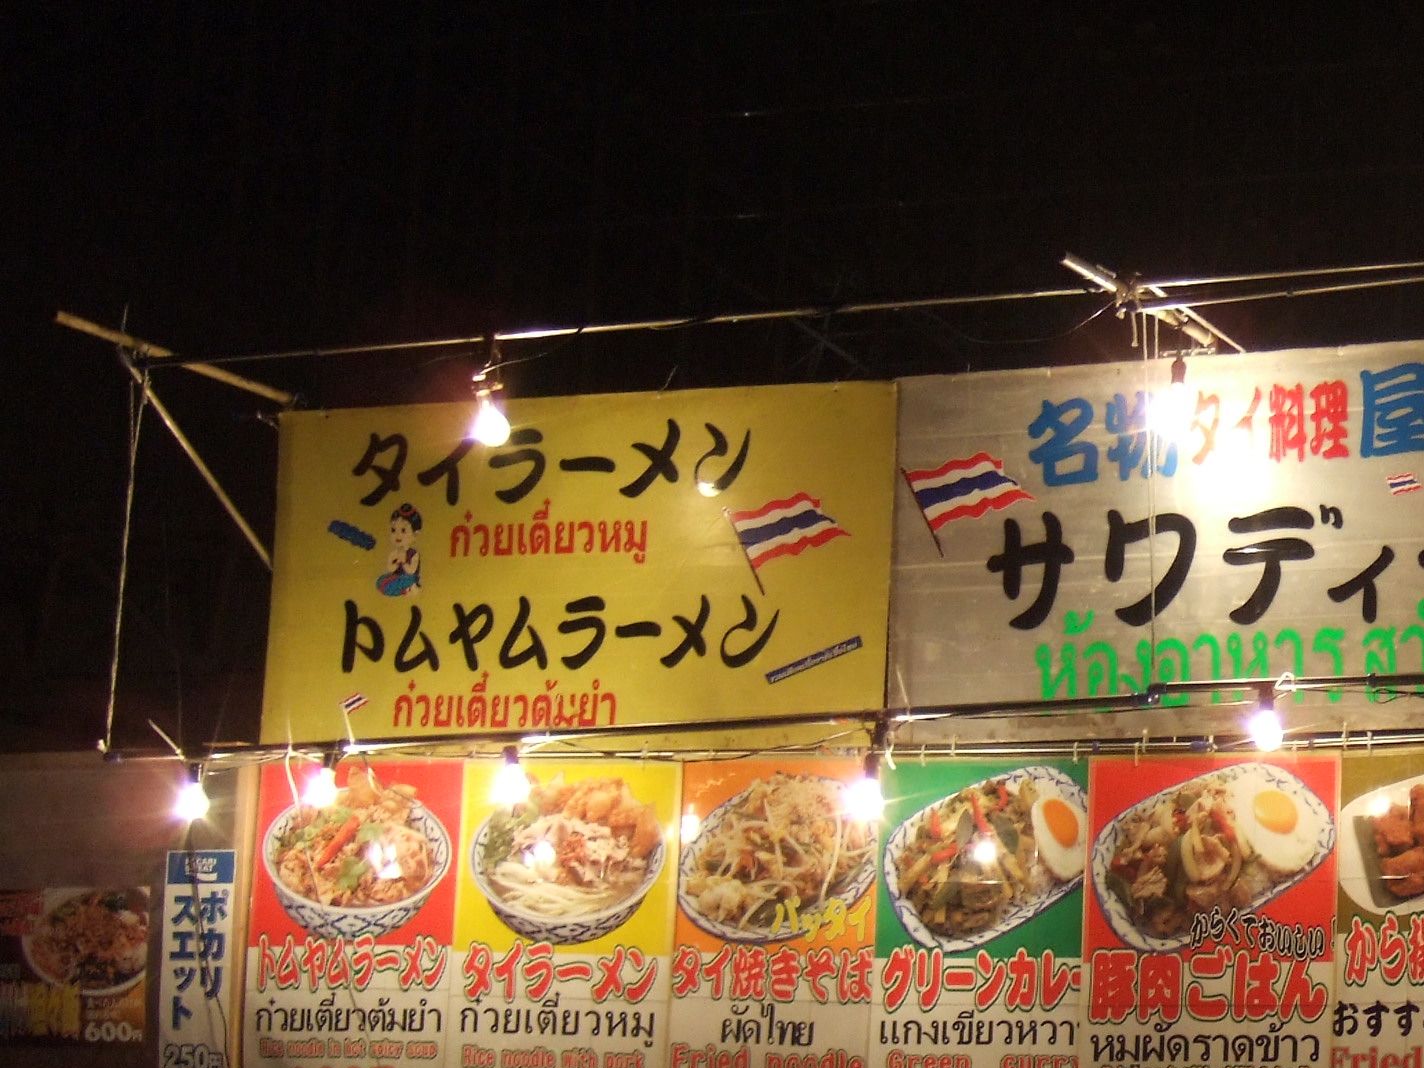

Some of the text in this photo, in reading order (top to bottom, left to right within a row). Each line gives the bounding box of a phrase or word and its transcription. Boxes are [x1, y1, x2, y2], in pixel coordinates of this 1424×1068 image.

[351, 418, 752, 507] タイラーメン
[341, 595, 780, 673] トムヤムラーメン
[169, 895, 198, 1030] スエット
[199, 888, 229, 998] ポカリ
[256, 933, 448, 992] トムヤムラーメン
[462, 939, 658, 1003] タイラーメン
[672, 944, 873, 1004] タイ焼きそば
[1089, 947, 1328, 1024] 豚肉ごはん
[462, 1044, 496, 1068] Rice
[879, 1010, 1080, 1046] แกงเขียวหวา
